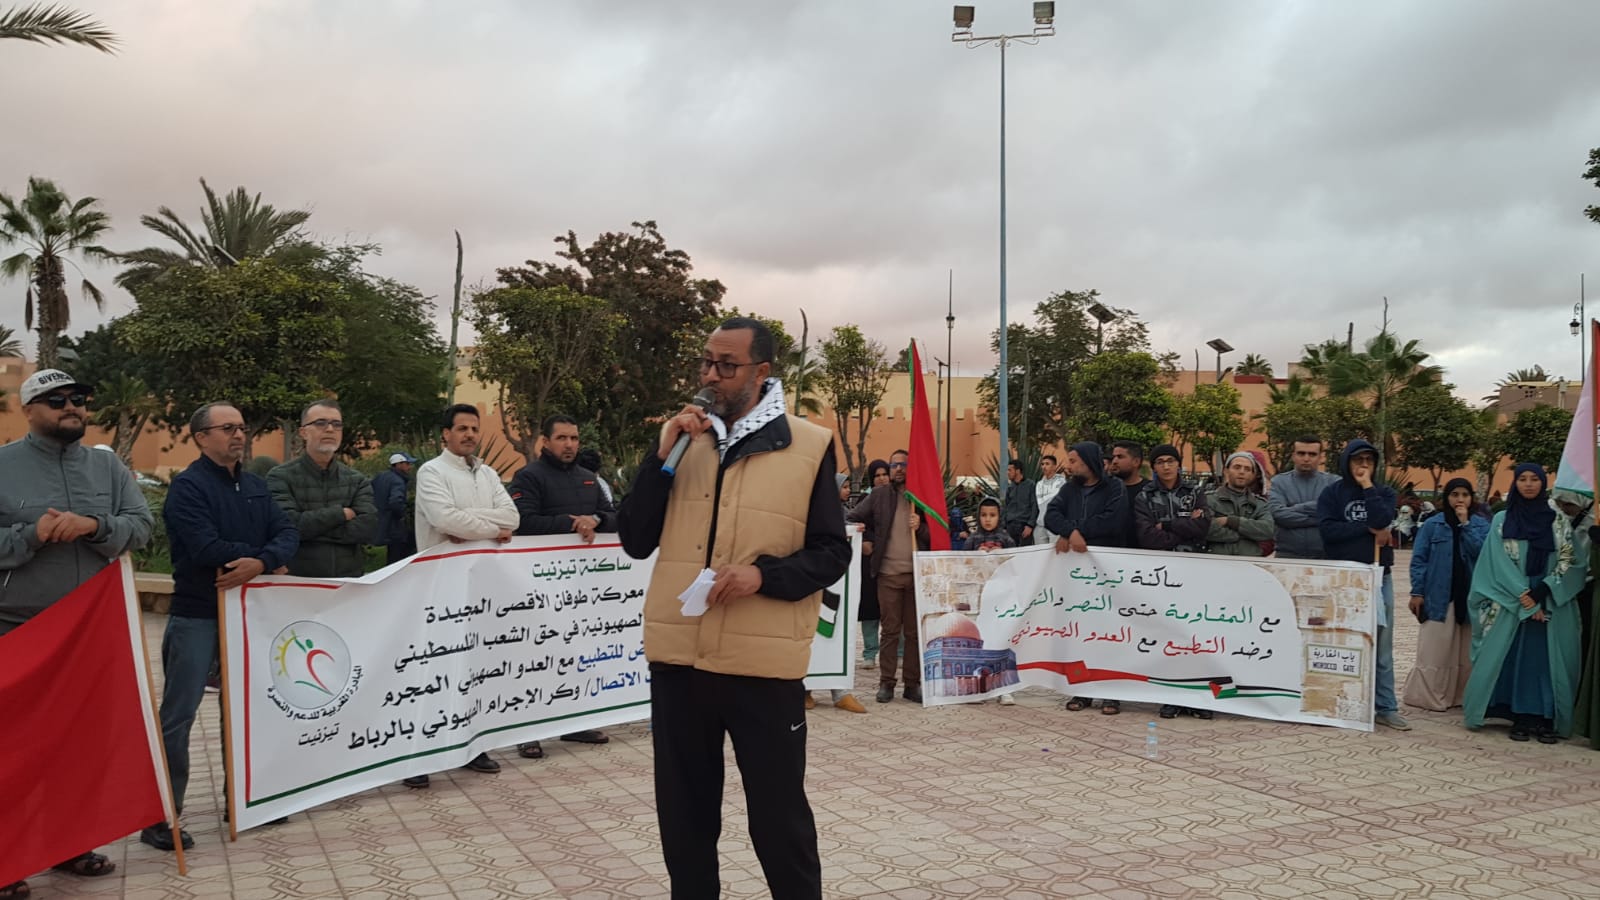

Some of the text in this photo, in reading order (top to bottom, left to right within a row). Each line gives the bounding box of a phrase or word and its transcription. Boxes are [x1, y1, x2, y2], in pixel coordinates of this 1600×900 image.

[532, 556, 632, 581] ساكنة تيزنيت
[1070, 565, 1183, 588] ساكنة تيزنيت
[424, 586, 644, 623] معركة طوفان الأقصى المجيدة
[1065, 594, 1112, 612] النصر
[1118, 603, 1158, 617] حتى
[1165, 603, 1253, 624] المقاومة
[534, 625, 559, 645] حق
[563, 620, 579, 644] في
[581, 613, 642, 637] لصهيونية
[1084, 626, 1131, 643] العدو
[1259, 616, 1281, 632] مع
[483, 626, 530, 650] الشعب
[1137, 637, 1157, 653] مع
[1163, 634, 1226, 656] التطبيع
[577, 644, 624, 672] للتطبيع
[1231, 642, 1273, 660] وضد
[514, 656, 553, 679] العدو
[557, 657, 574, 675] مع
[381, 674, 449, 707] المجرم
[485, 687, 542, 713] الإجرام
[546, 683, 580, 705] وكر
[298, 722, 340, 746] تيزنيت
[348, 719, 415, 750] بالرباط
